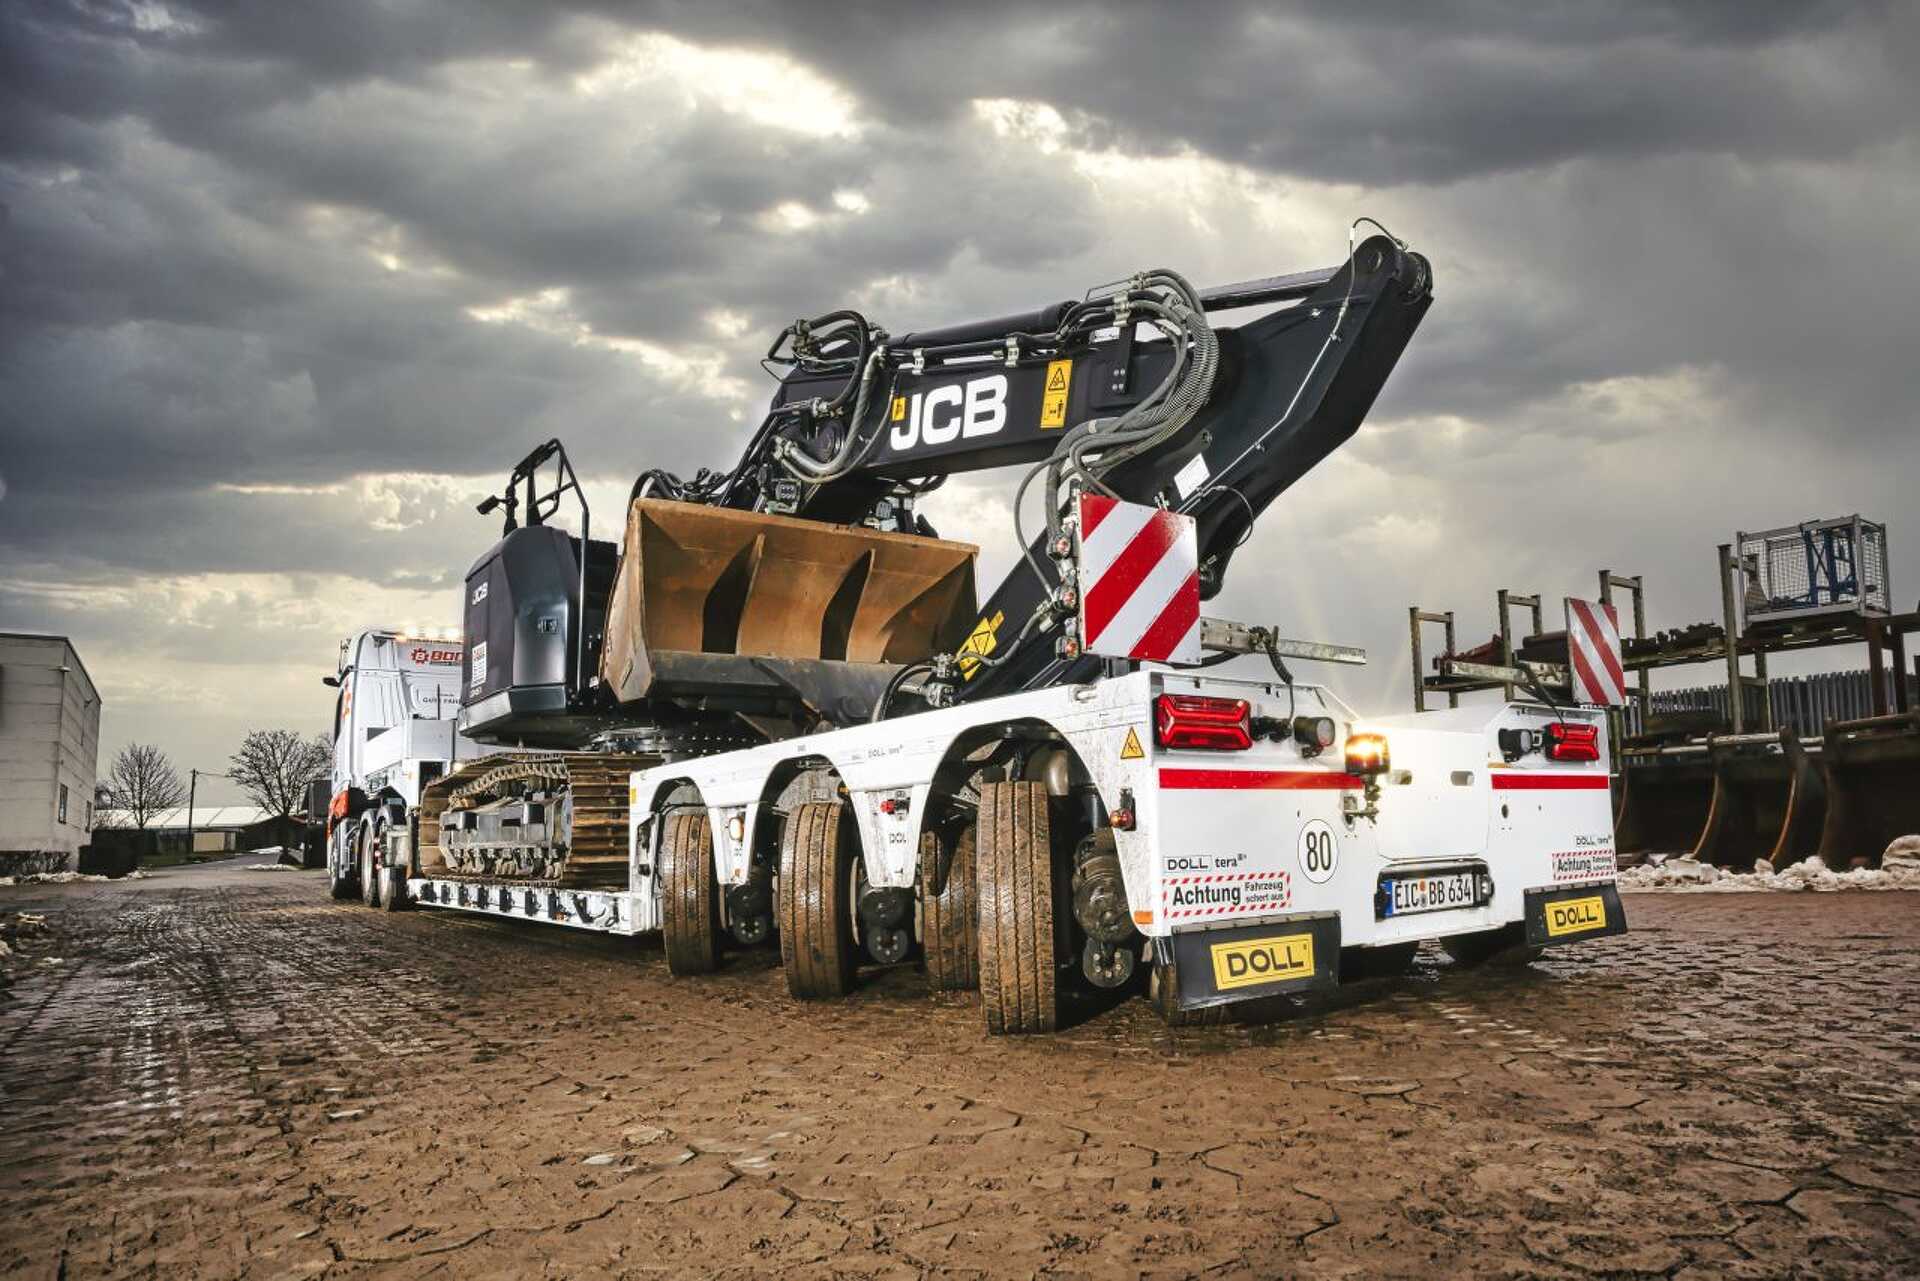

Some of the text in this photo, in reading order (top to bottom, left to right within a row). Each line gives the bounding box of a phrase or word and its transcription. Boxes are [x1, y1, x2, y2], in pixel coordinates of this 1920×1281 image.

[890, 374, 1008, 451] JCB
[471, 581, 489, 606] JCB
[1306, 831, 1332, 872] 80
[1575, 836, 1595, 846] DOLL
[1167, 858, 1209, 870] DOLL
[1557, 858, 1592, 873] Achtung
[1173, 881, 1284, 906] Achtung Fahrzeug
[1246, 894, 1269, 903] schert
[1394, 878, 1472, 910] EIC BB 634
[1553, 904, 1598, 928] DOLL
[1226, 945, 1305, 977] DOLL
